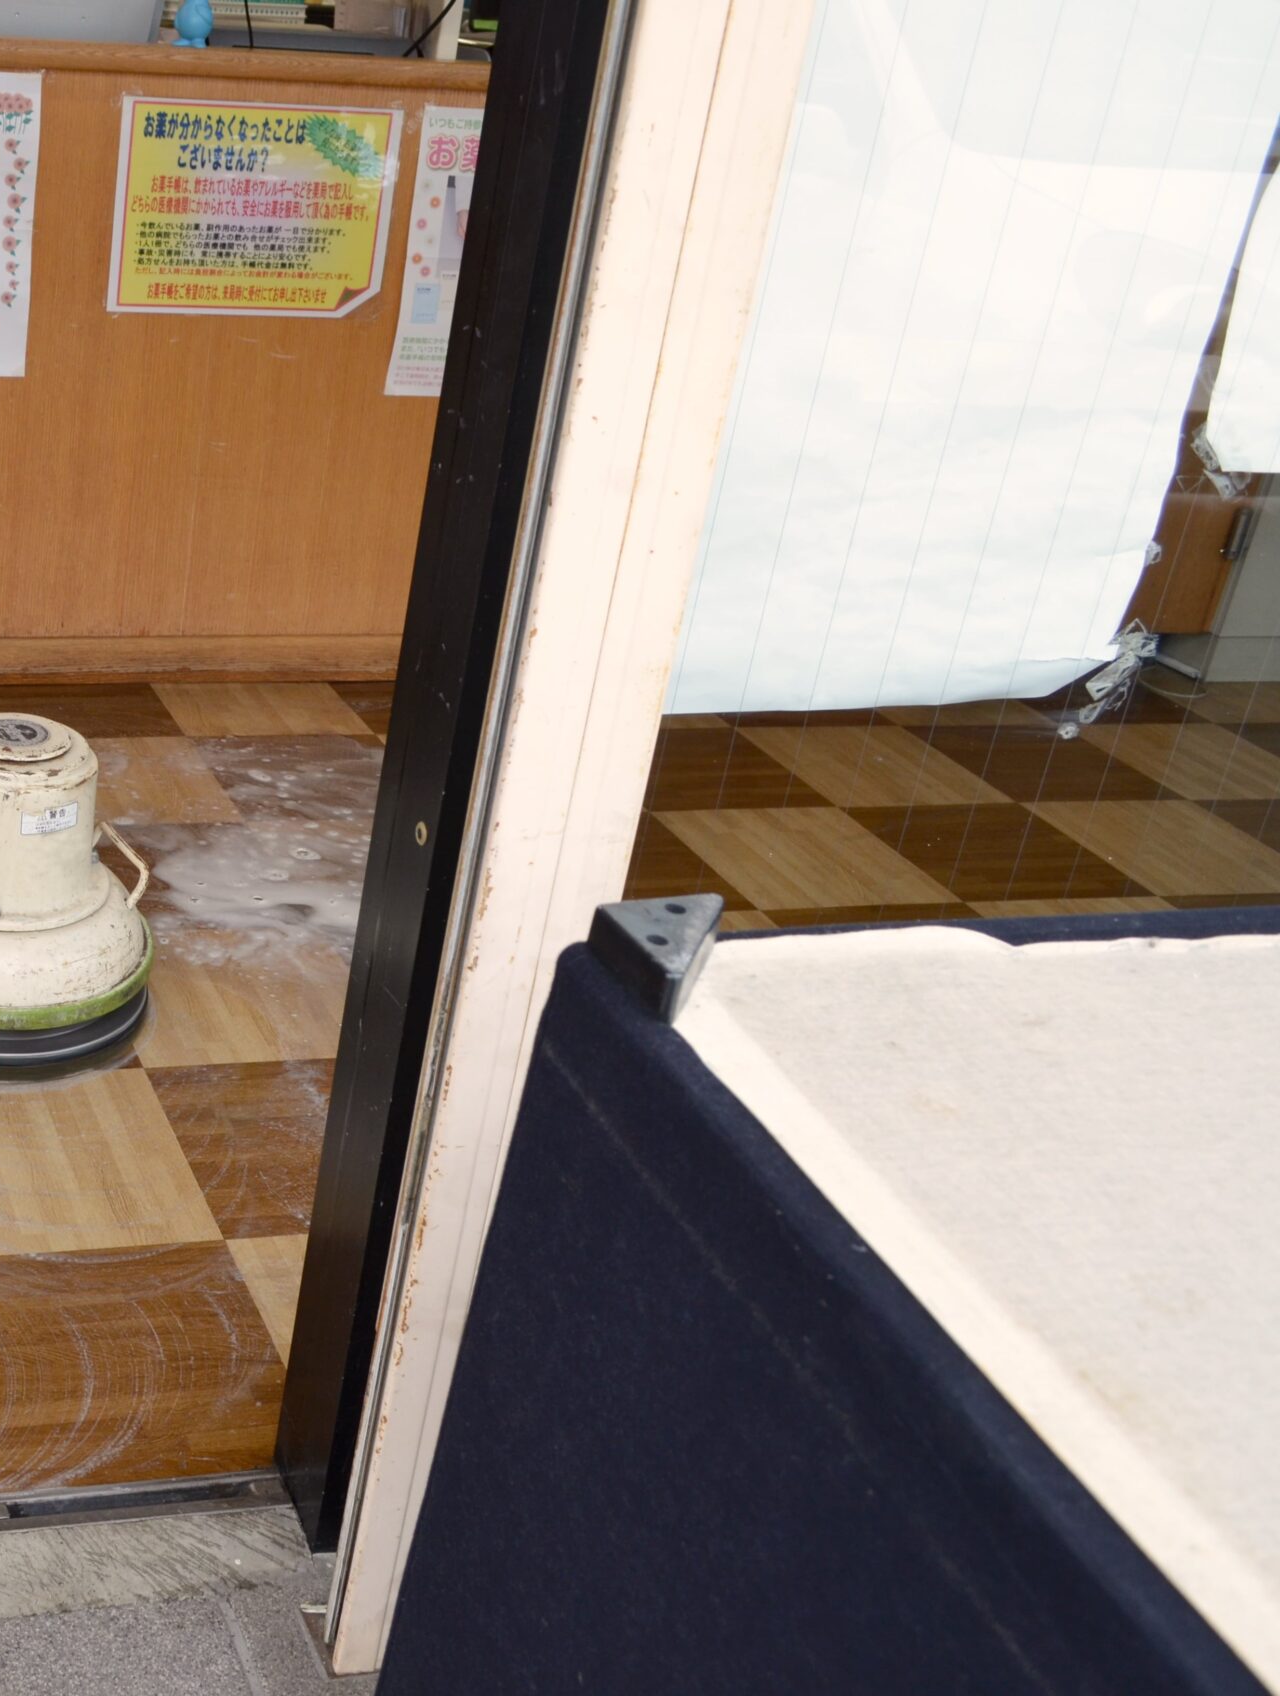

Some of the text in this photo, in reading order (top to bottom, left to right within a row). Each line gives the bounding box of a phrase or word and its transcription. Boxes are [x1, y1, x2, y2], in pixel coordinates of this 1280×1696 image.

[144, 111, 307, 144] お薬が分からなくなったことは
